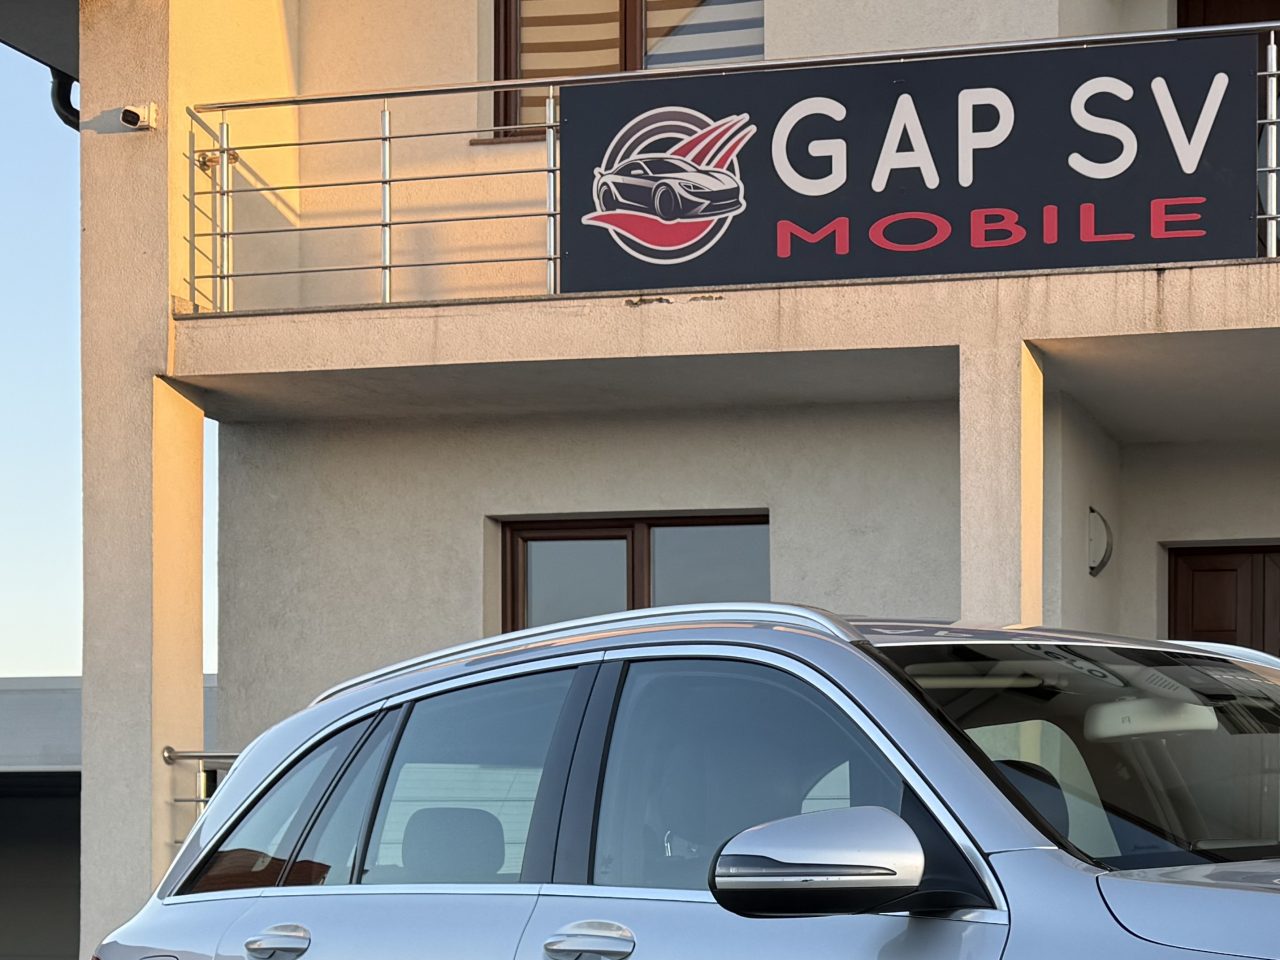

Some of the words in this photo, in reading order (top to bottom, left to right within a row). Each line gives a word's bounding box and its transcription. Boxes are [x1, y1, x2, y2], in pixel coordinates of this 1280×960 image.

[771, 87, 1015, 197] GAP
[1067, 72, 1230, 180] SV
[776, 196, 1208, 259] MOBILE
